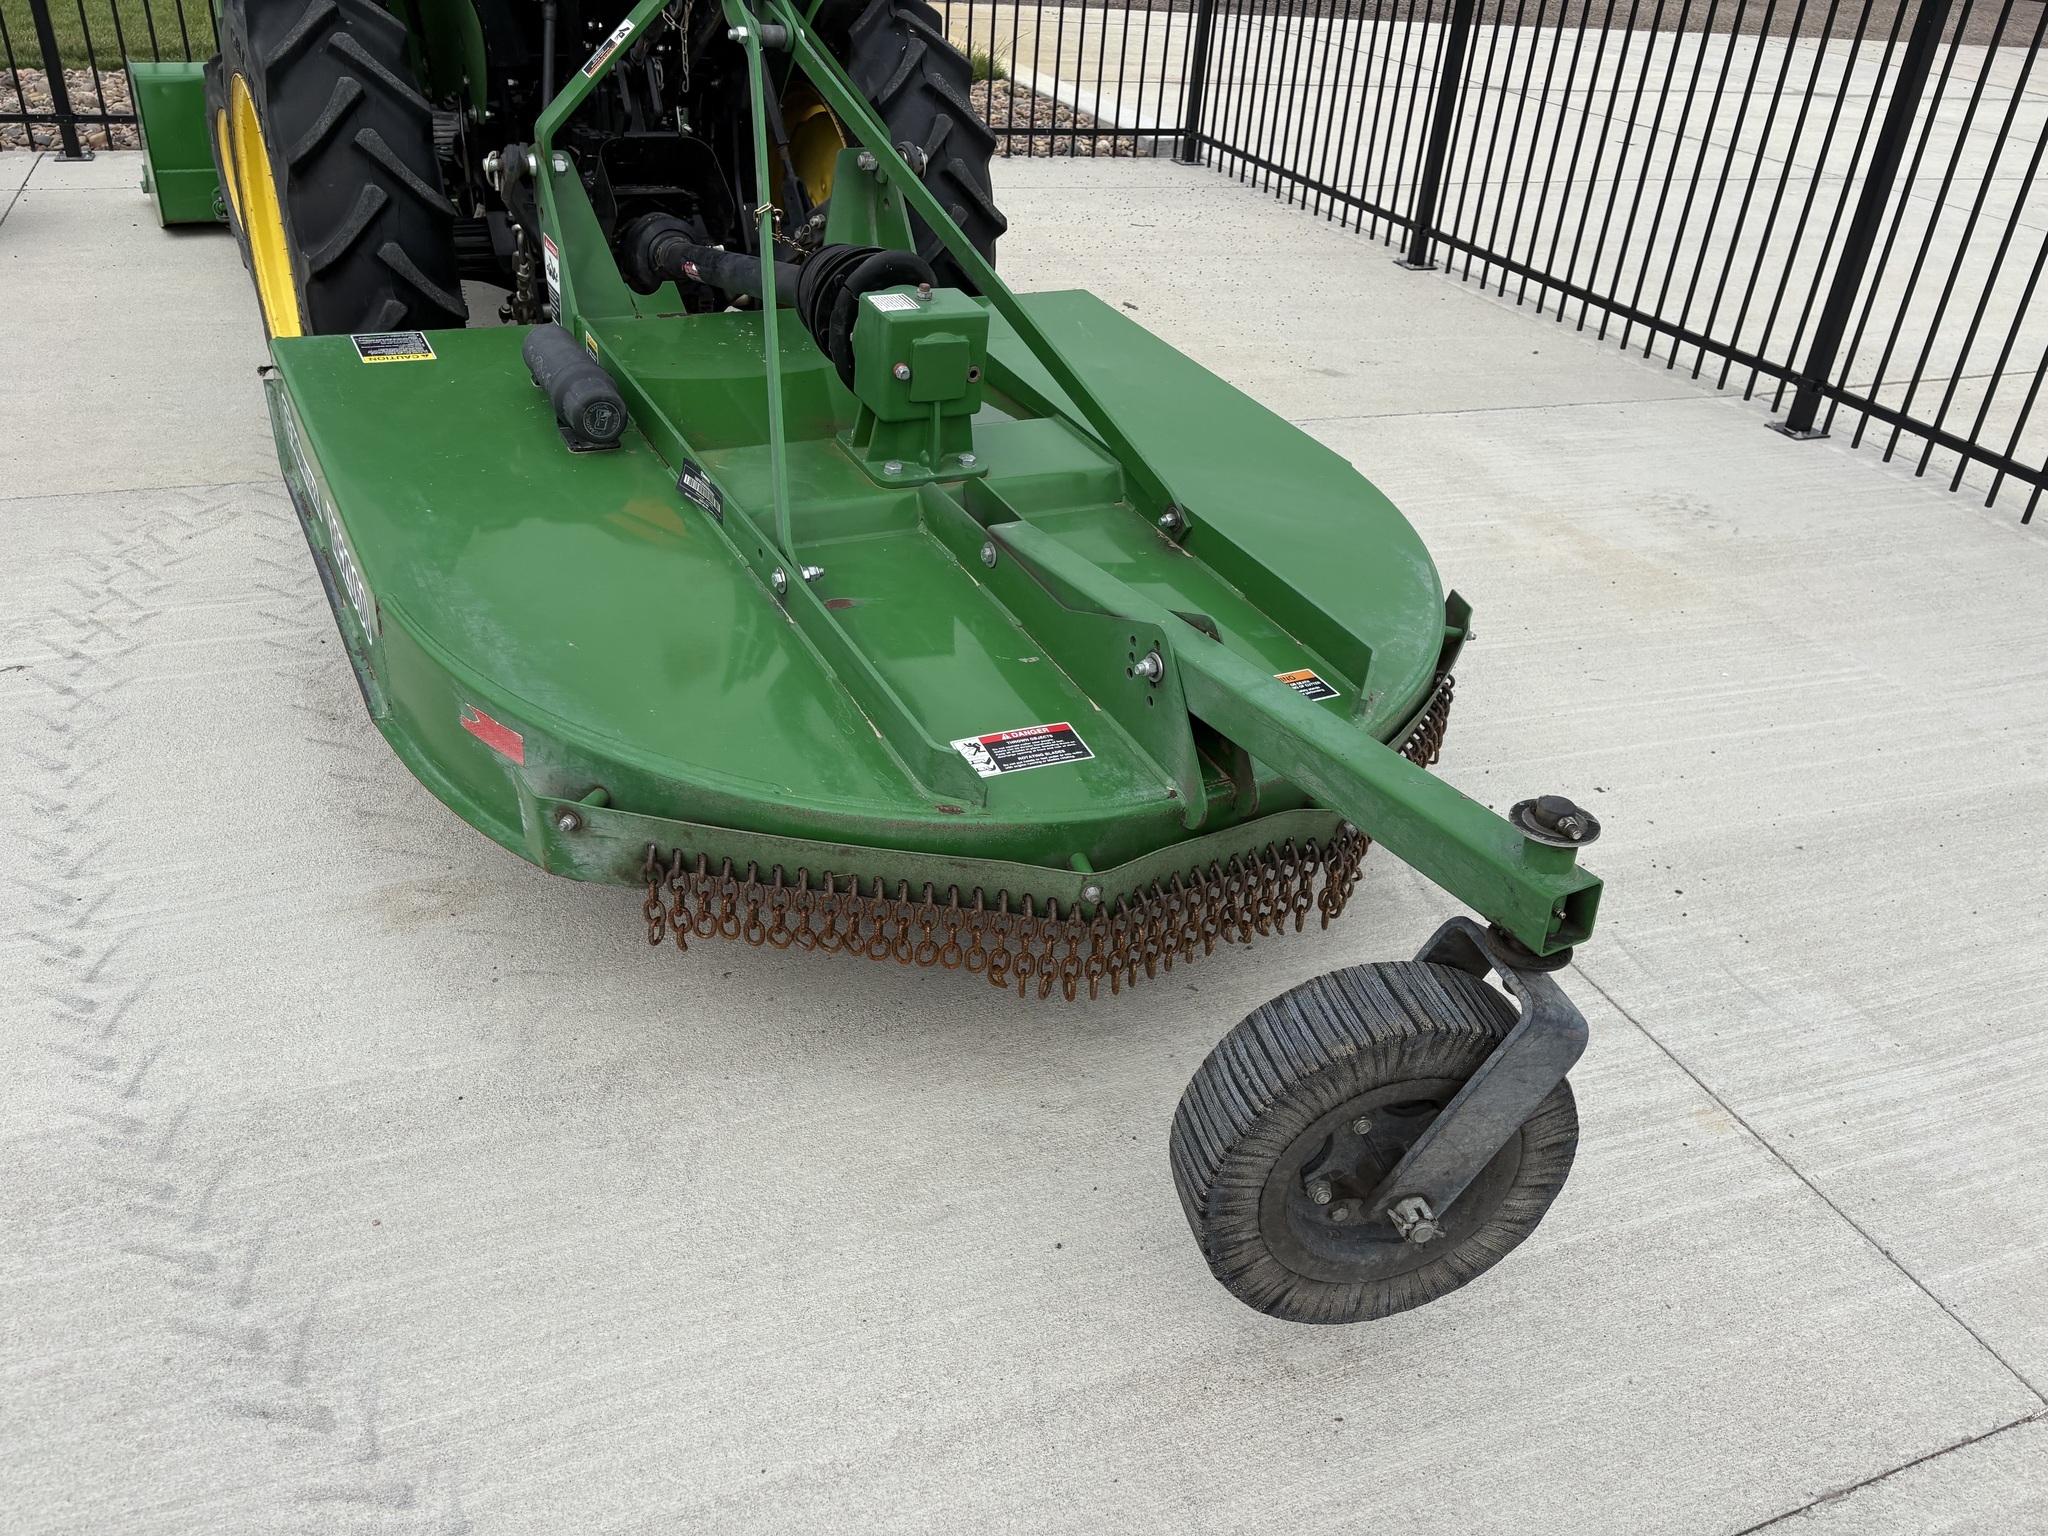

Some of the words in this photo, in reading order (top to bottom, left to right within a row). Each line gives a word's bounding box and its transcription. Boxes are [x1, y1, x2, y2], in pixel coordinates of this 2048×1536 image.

[1011, 727, 1050, 738] DANGER
[1018, 752, 1044, 761] ROTATING
[1044, 749, 1066, 757] BLADES
